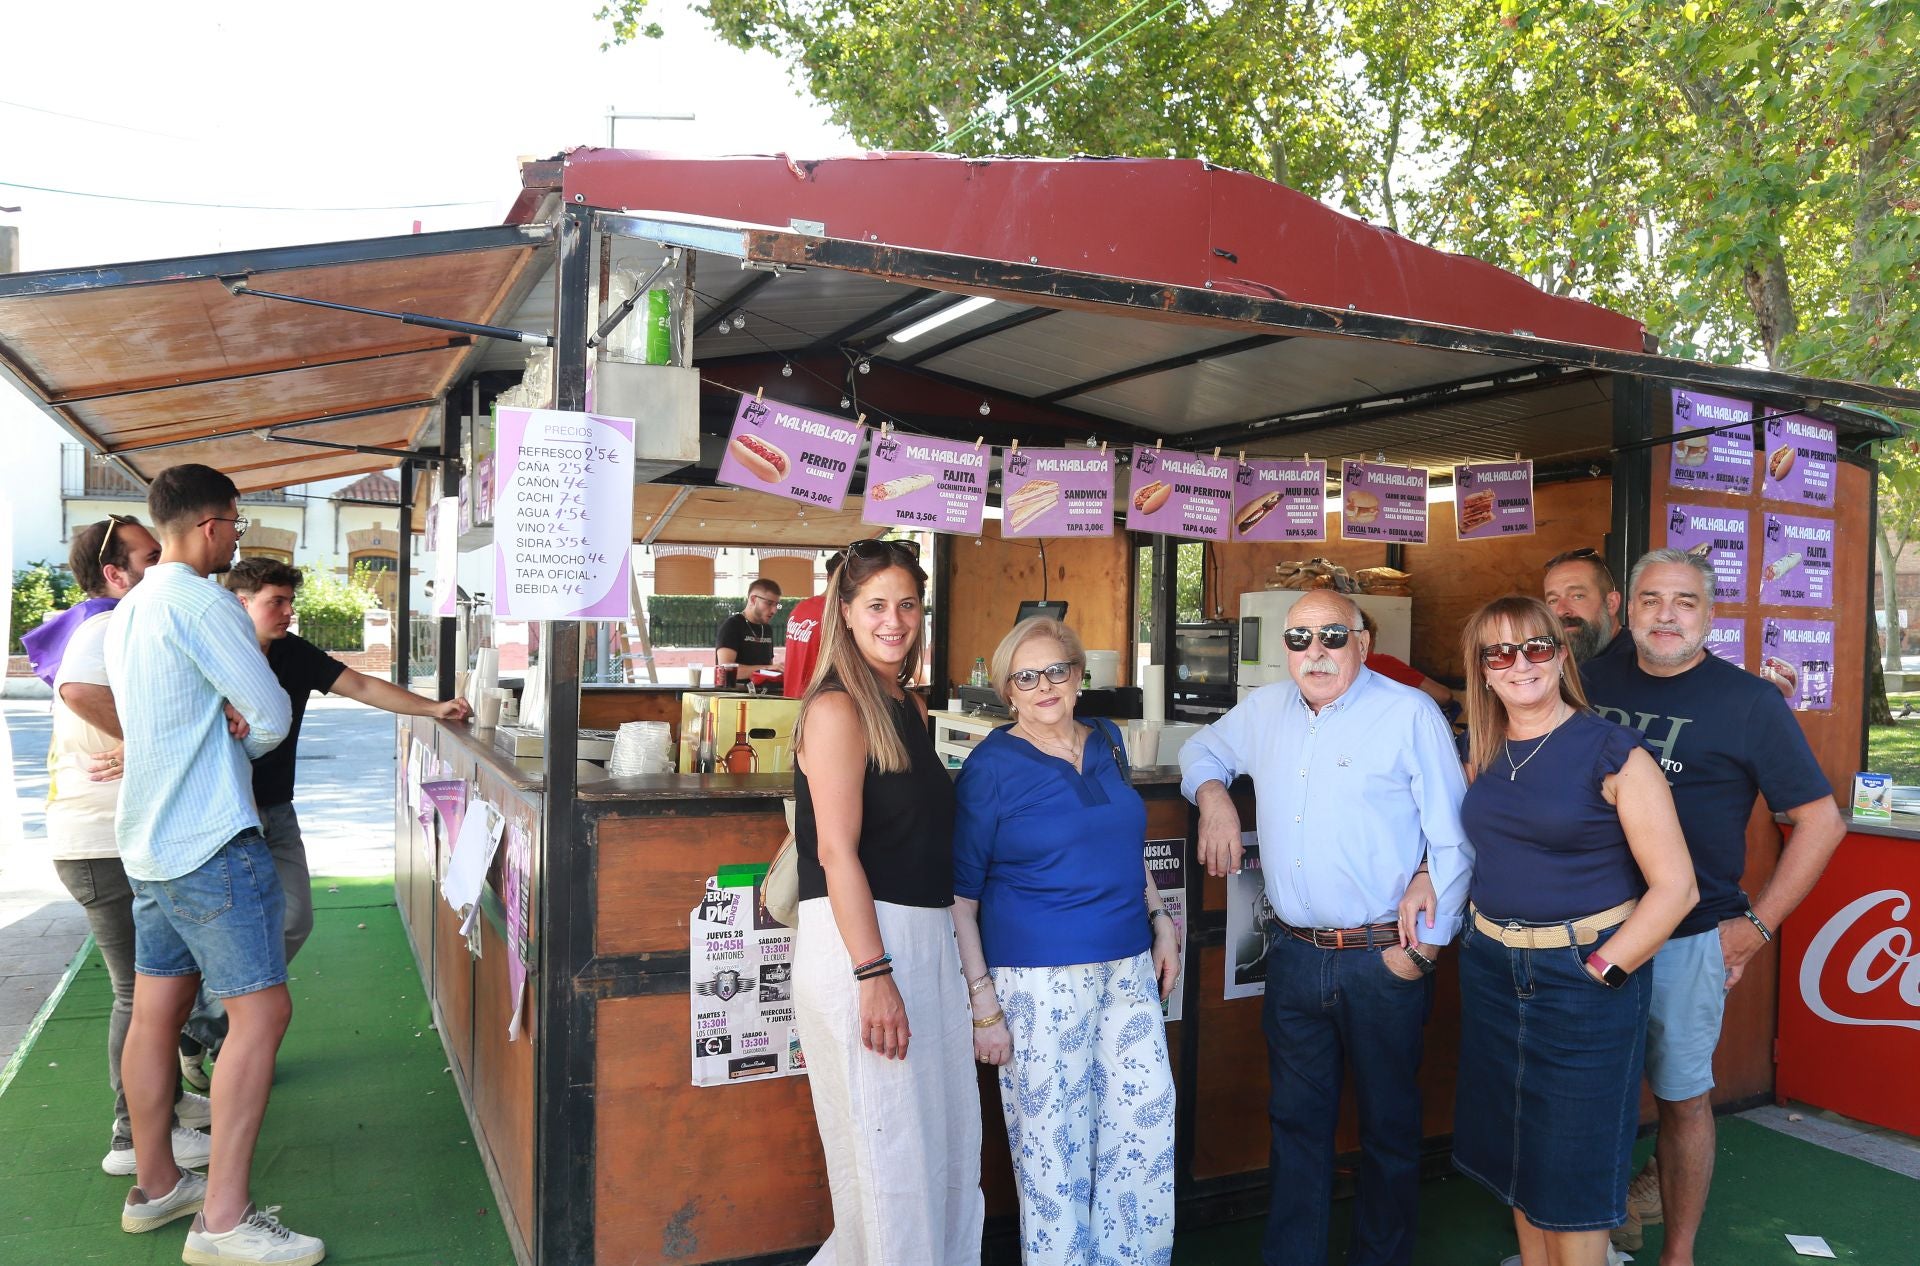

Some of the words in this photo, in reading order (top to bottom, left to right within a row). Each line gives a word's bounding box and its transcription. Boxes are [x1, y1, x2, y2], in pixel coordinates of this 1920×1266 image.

[1696, 403, 1749, 423] MALHABLADA
[544, 425, 593, 437] PRECIOS
[774, 413, 858, 445] MALHABLADA
[1786, 421, 1833, 442] MALHABLADA
[518, 446, 582, 459] REFRESCO
[906, 445, 983, 467] MALHABLADA
[1797, 447, 1810, 458] DON
[517, 461, 550, 472] CAÑA
[800, 451, 847, 472] PERRITO
[1036, 459, 1108, 473] MALHABLADA
[806, 467, 835, 480] CALIENTE
[943, 469, 975, 484] FAJITA
[1259, 469, 1320, 481] MALHABLADA
[1477, 470, 1528, 483] MALHABLADA
[1675, 468, 1694, 478] OFICIAL
[517, 475, 559, 488] CAÑÓN
[1367, 472, 1424, 488] MALHABLADA
[937, 483, 967, 493] COCHINITA
[1174, 483, 1191, 494] DON
[1193, 486, 1231, 499] PERRITON
[1285, 487, 1302, 496] MUU
[1303, 487, 1320, 496] RICA
[517, 491, 553, 503] CACHI
[791, 486, 809, 498] TAPA
[810, 491, 832, 504] 3,00€
[1064, 489, 1107, 500] SANDWICH
[517, 507, 550, 518] AGUA
[896, 510, 914, 520] TAPA
[916, 512, 937, 522] 3,50€
[516, 522, 545, 533] VINO
[1066, 523, 1083, 531] TAPA
[1084, 523, 1104, 532] 3,00€
[1182, 523, 1198, 533] TAPA
[1199, 526, 1217, 535] 4,00€
[1347, 525, 1366, 534] OFICIAL
[1502, 524, 1514, 532] TAPA
[1690, 516, 1745, 533] MALHABLADA
[1285, 528, 1300, 536] TAPA
[1301, 528, 1318, 537] 5,50€
[1784, 525, 1831, 542] MALHABLADA
[516, 537, 552, 548] SIDRA
[1713, 539, 1729, 549] MUU
[1729, 540, 1744, 550] RICA
[516, 552, 586, 565] CALIMOCHO
[1806, 546, 1827, 559] FAJITA
[516, 568, 545, 579] TAPA
[547, 569, 591, 581] OFICIAL
[515, 583, 558, 594] BEBIDA
[1714, 588, 1724, 597] APA
[1783, 629, 1831, 644] MALHABLADA
[1144, 843, 1172, 858] ÚSICA
[727, 894, 741, 926] PALENCIA
[706, 931, 732, 940] JUEVES
[733, 930, 744, 938] 28
[706, 939, 744, 952] 20:45H
[760, 943, 790, 954] 13:30H
[706, 953, 711, 961] 4
[712, 950, 745, 961] KANTONES
[763, 954, 769, 962] EL
[770, 953, 786, 961] CRUCE
[697, 1011, 721, 1020] MARTES
[766, 1016, 770, 1024] Y
[771, 1014, 792, 1023] JUEVES
[697, 1018, 727, 1030] 13:30H
[696, 1029, 706, 1038] LOS
[706, 1027, 728, 1037] CORITOS
[740, 1037, 769, 1049] 13:30H
